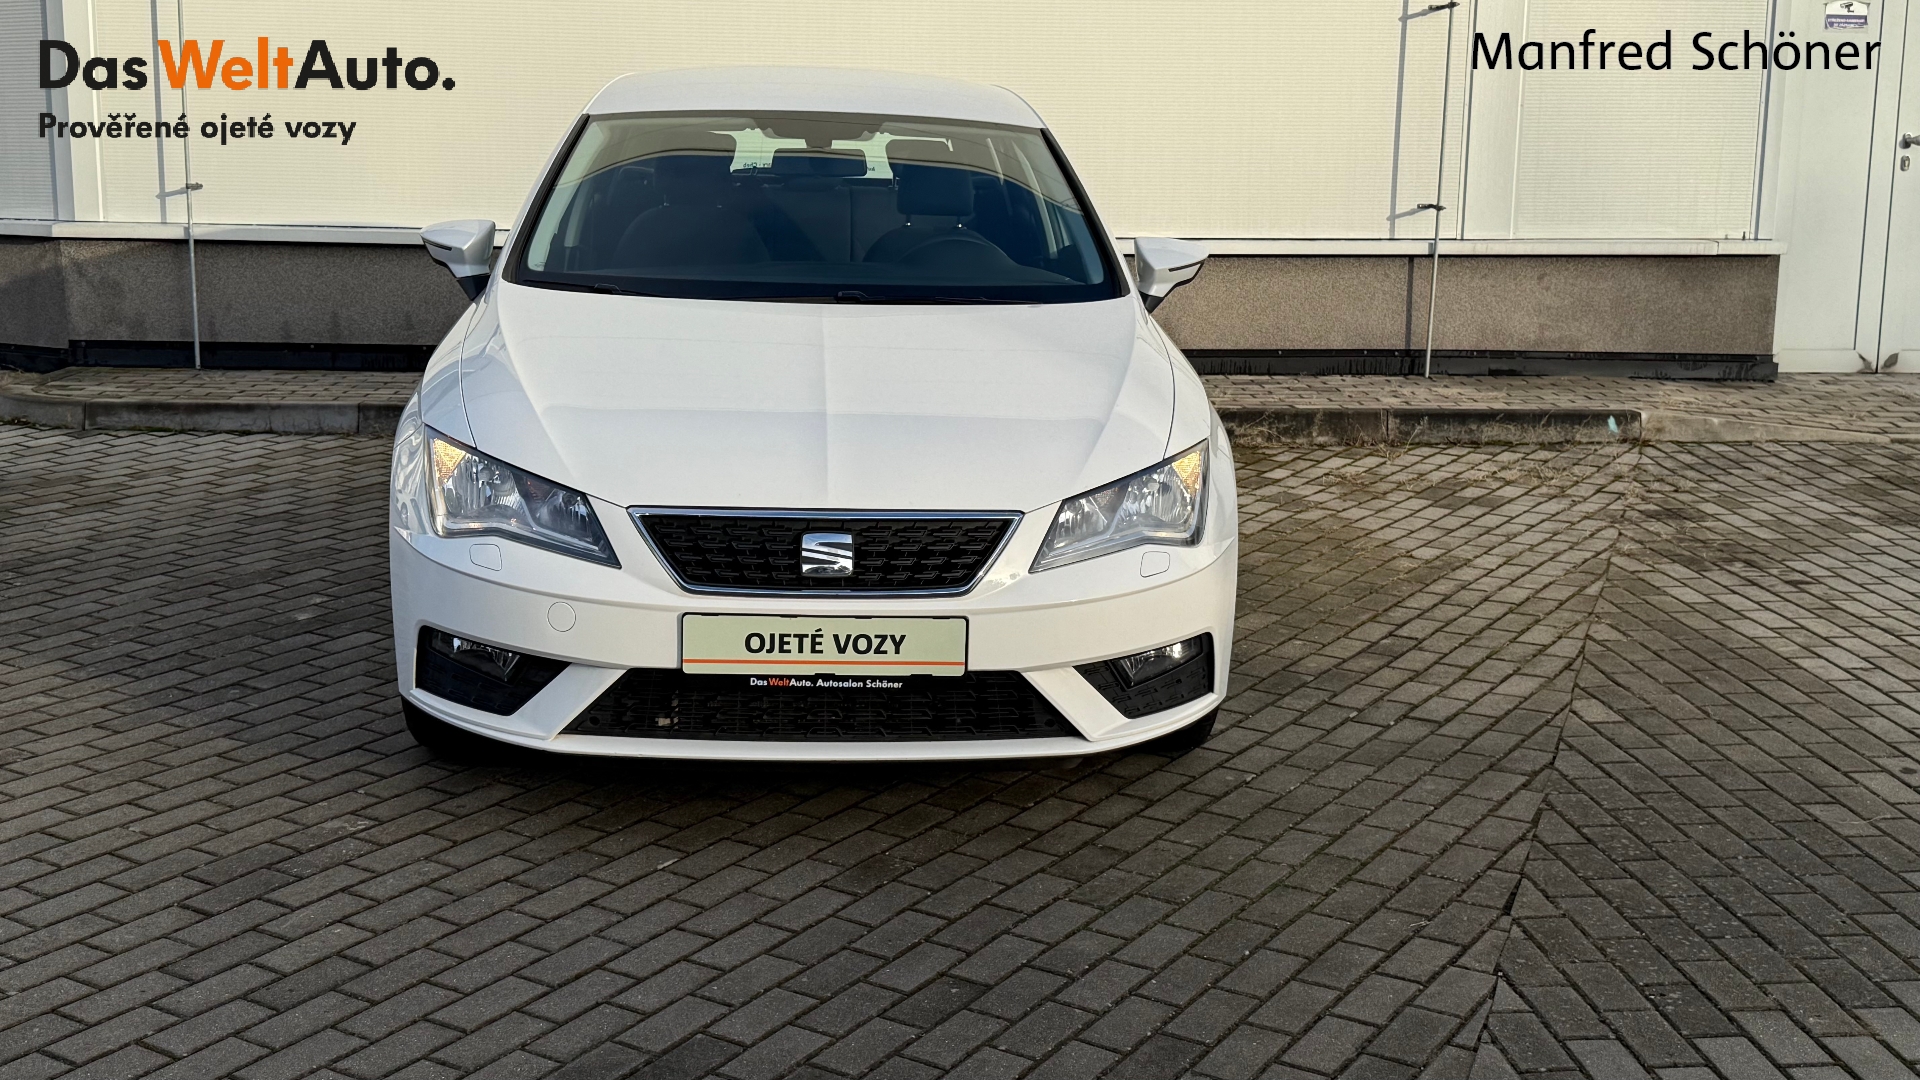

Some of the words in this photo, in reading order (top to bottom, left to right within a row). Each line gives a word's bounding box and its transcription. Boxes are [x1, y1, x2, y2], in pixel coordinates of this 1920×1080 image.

[744, 627, 824, 655] OJETÉ
[832, 633, 907, 655] VOZY
[815, 678, 864, 688] Autosalon
[865, 679, 904, 689] Schöner
